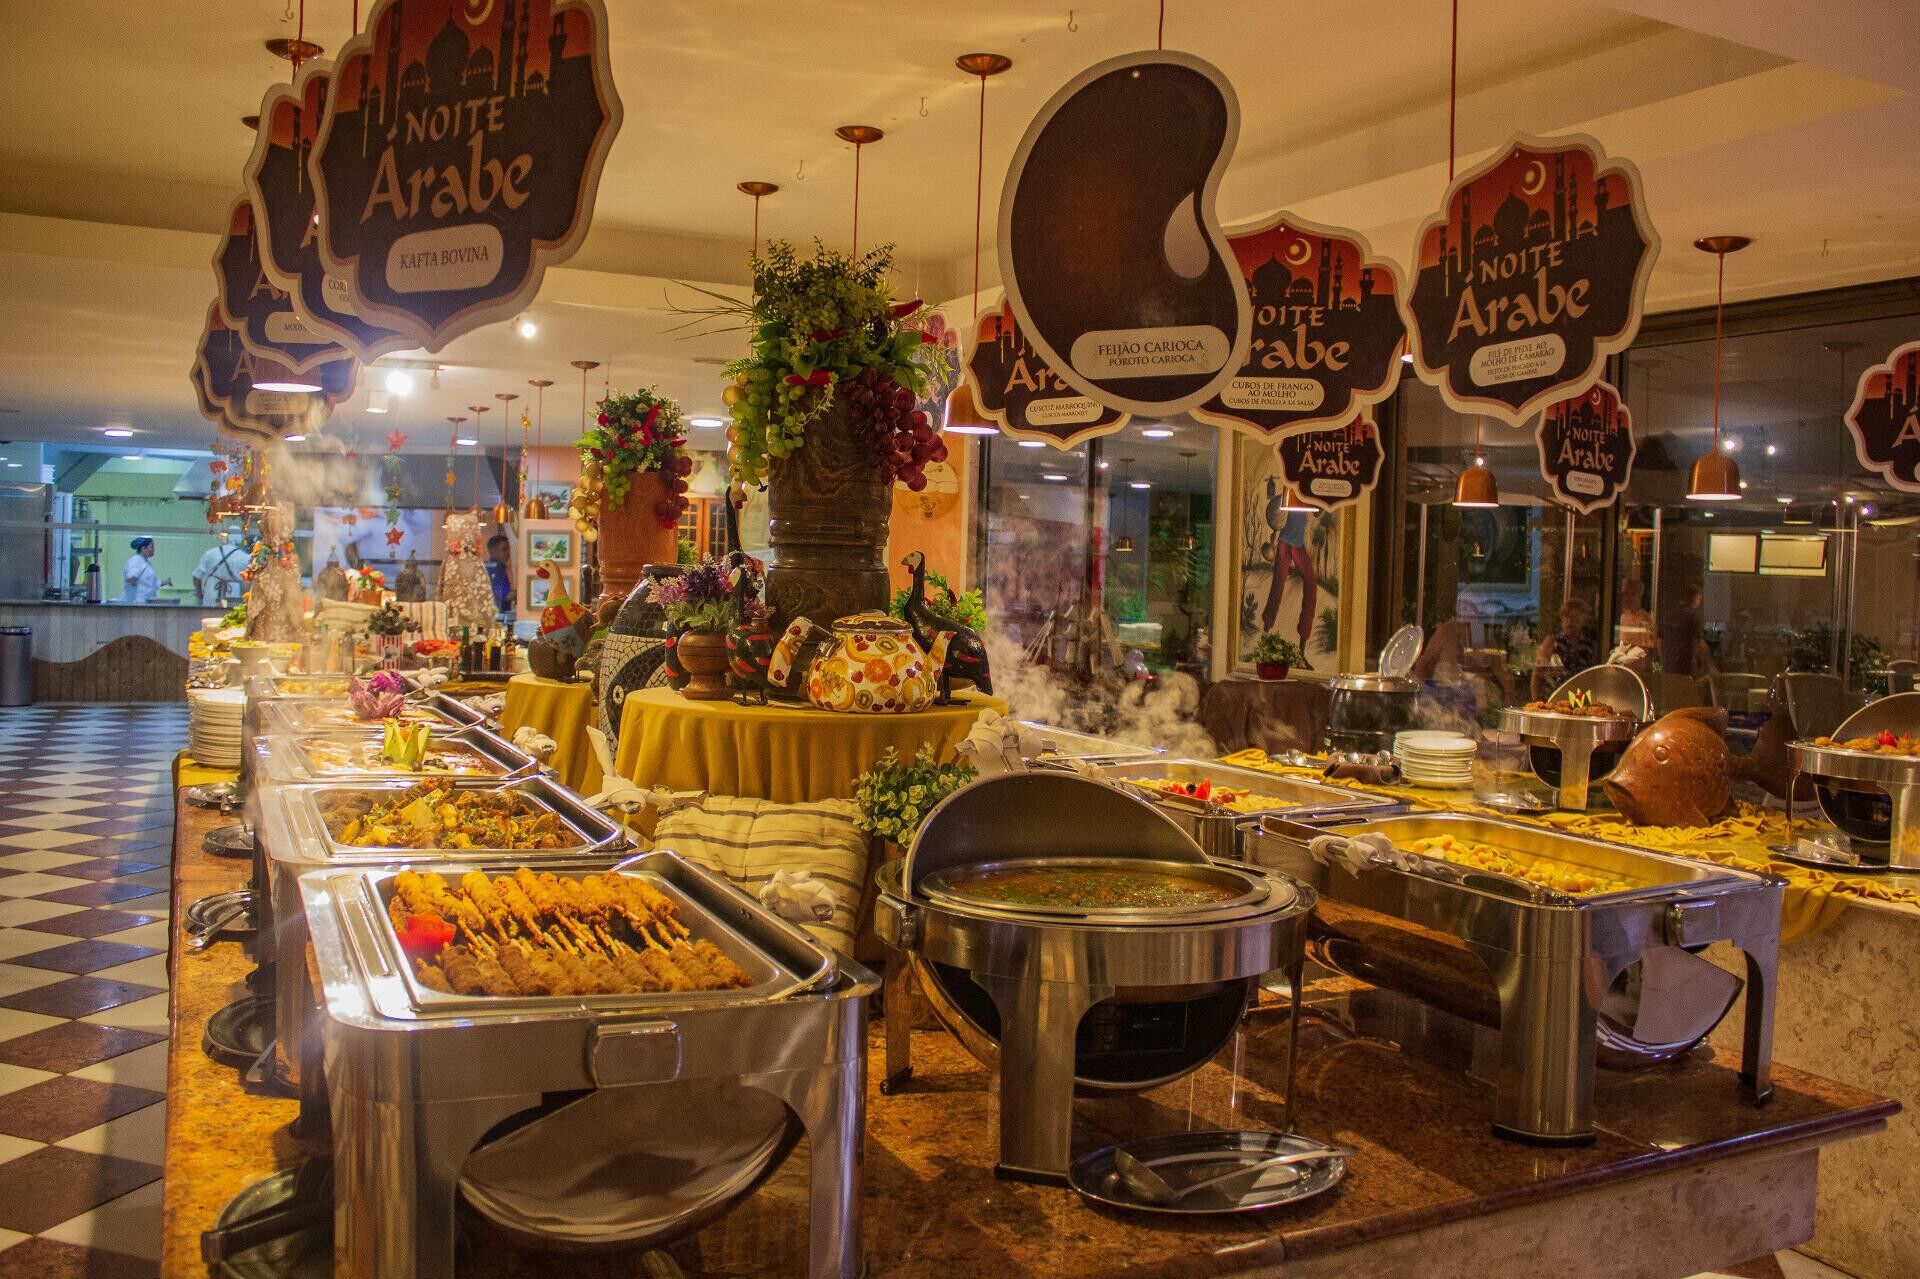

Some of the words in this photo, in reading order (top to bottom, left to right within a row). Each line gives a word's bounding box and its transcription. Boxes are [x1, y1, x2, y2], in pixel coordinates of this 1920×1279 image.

[405, 96, 505, 144] NOITE
[360, 124, 533, 224] Árabe
[400, 251, 438, 270] KAFTA
[441, 246, 489, 264] BOVINA
[1480, 240, 1564, 285] NOITE
[1253, 305, 1326, 326] OITE
[1447, 266, 1590, 344] Árabe
[1098, 341, 1141, 357] FEIJÃO
[1144, 339, 1205, 354] CARIOCA
[1109, 355, 1149, 367] POROTO
[1151, 353, 1196, 364] CARIOCA
[1232, 382, 1260, 390] CUBOS
[1263, 382, 1275, 390] DE
[1277, 383, 1314, 391] FRANGO
[1262, 390, 1297, 398] MOLHO
[1572, 427, 1606, 444] NOITE
[1313, 440, 1350, 454] NOITE
[1557, 431, 1614, 472] Árabe
[1298, 444, 1360, 475] Árabe
